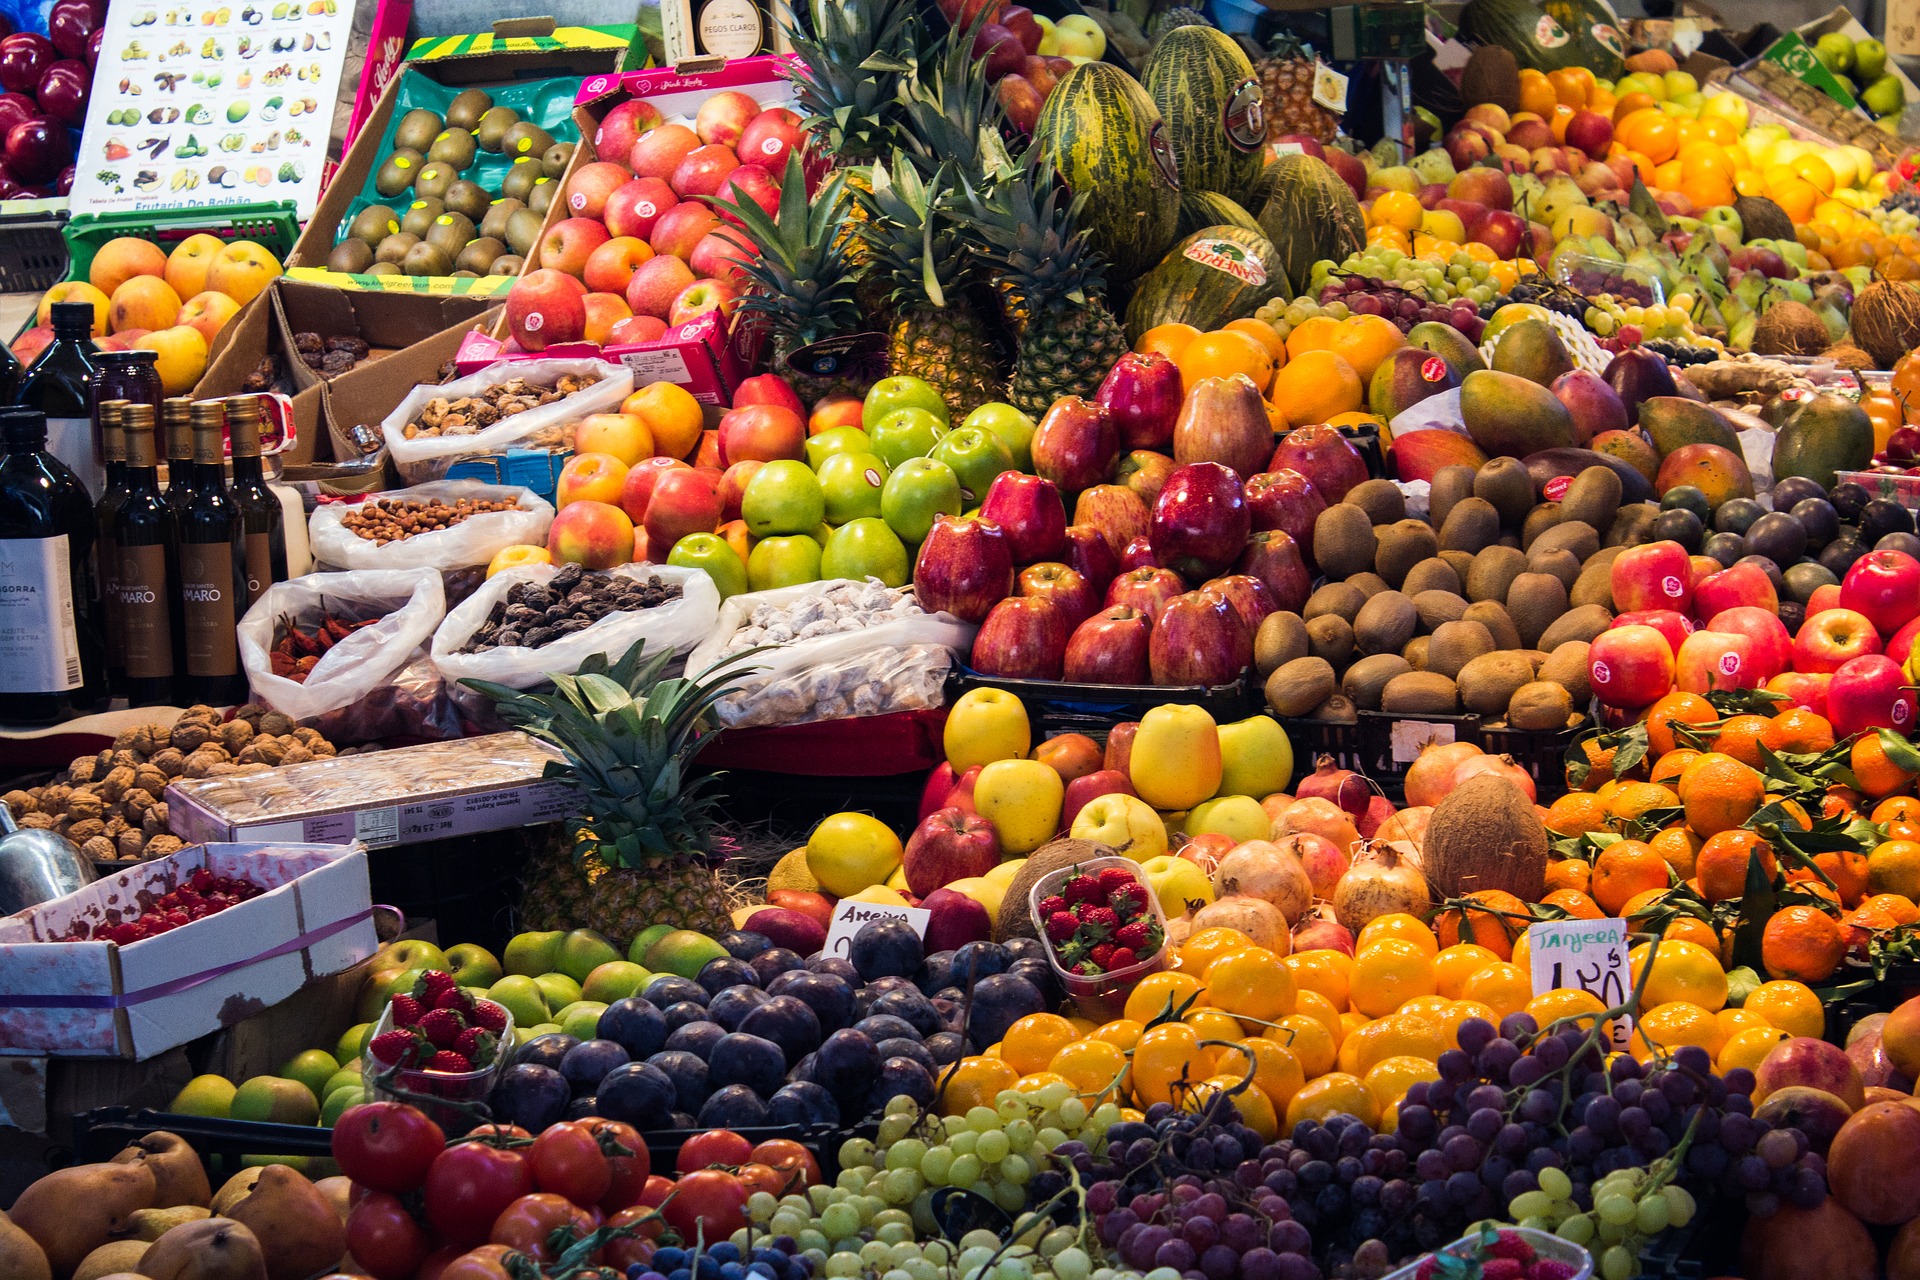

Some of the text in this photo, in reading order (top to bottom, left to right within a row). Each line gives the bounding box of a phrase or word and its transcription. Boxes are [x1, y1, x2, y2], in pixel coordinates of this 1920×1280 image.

[704, 23, 757, 33] PEGOS CLAROS
[660, 77, 705, 91] Pink Lady
[135, 196, 251, 211] Frutaria Do Bolhão
[347, 279, 454, 290] www.kiwigreensun.com
